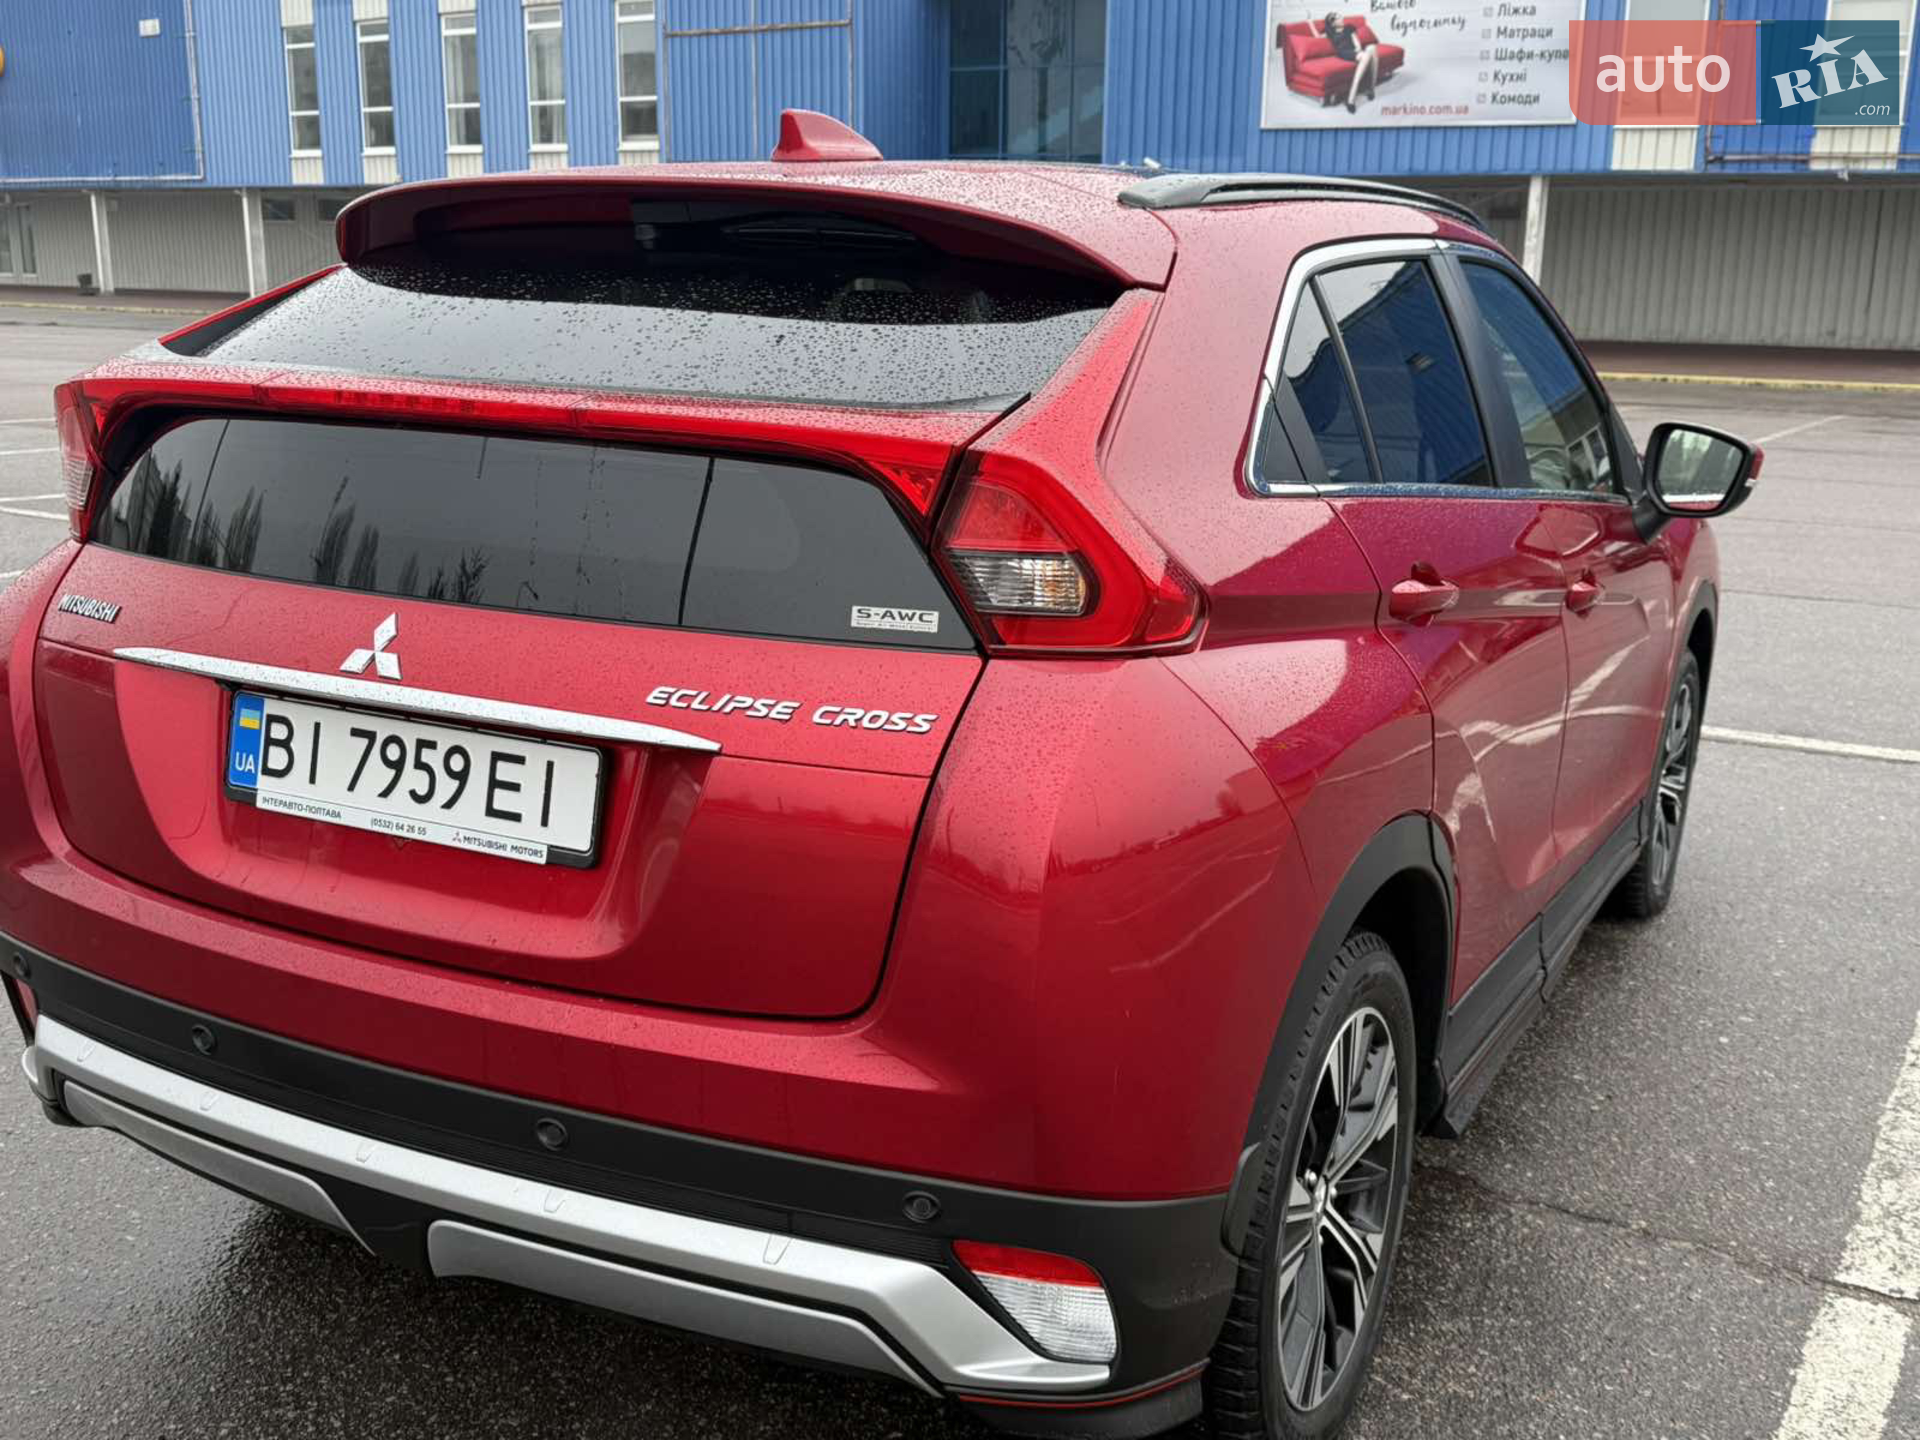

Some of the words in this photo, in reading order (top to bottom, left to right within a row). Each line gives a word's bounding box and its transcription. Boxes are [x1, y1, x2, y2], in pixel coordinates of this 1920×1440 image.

[1497, 3, 1537, 17] Ліжка
[1496, 26, 1553, 41] Матраци
[1492, 69, 1527, 85] Кухні
[1491, 91, 1540, 105] Комоди
[1381, 102, 1469, 115] markino.com.ua
[57, 594, 121, 624] MITSUBISHI
[856, 608, 934, 624] S-AWC
[646, 686, 801, 721] ECLIPSE
[812, 706, 939, 734] CROSS
[234, 751, 256, 774] UA
[260, 713, 322, 786] BI
[346, 727, 472, 810] 7959
[484, 750, 555, 828] EI
[370, 817, 394, 832] (0532)
[395, 821, 405, 831] 64
[406, 824, 416, 834] 26
[417, 826, 428, 836] 55
[462, 835, 508, 852] MITSUBISHI
[510, 844, 544, 858] MOTORS
